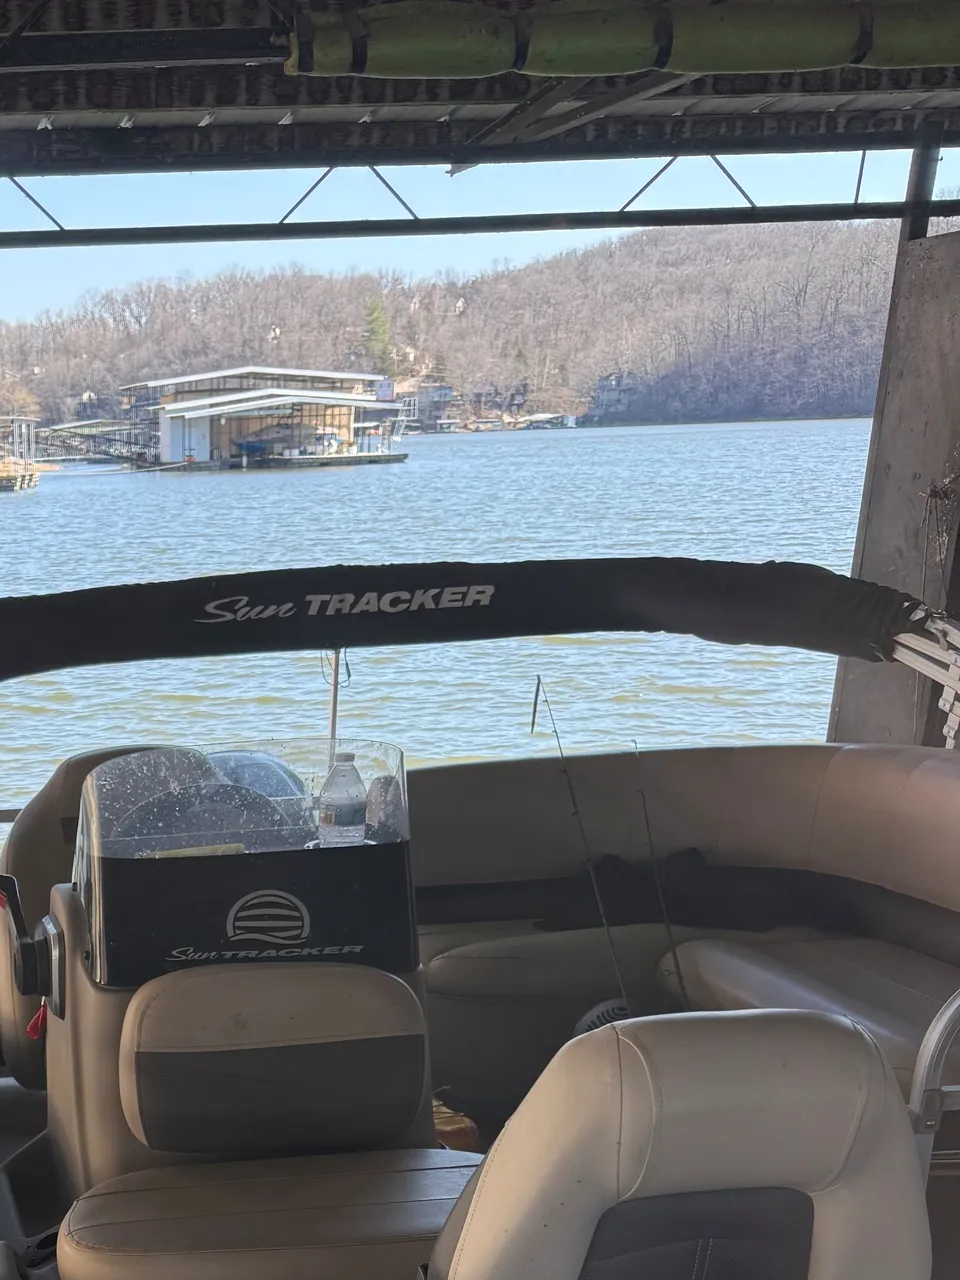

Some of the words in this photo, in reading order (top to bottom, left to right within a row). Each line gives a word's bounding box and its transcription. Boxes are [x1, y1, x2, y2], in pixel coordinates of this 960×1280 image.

[193, 595, 296, 623] Sun
[305, 584, 495, 616] TRACKER
[165, 947, 219, 961] Sun
[220, 945, 364, 958] TRACKER
